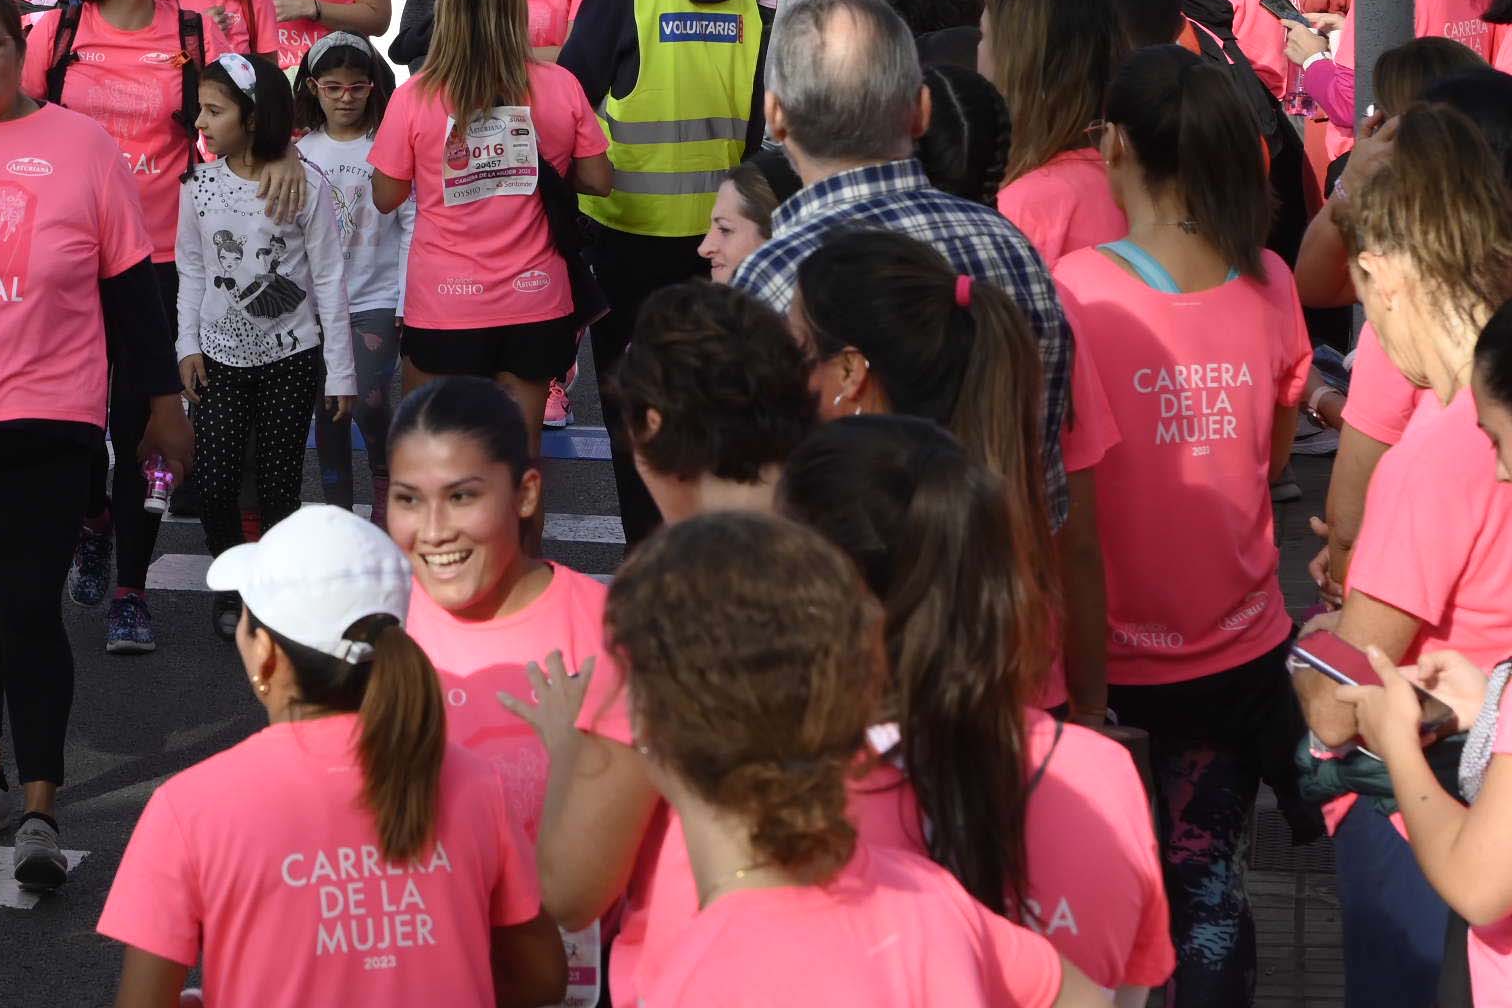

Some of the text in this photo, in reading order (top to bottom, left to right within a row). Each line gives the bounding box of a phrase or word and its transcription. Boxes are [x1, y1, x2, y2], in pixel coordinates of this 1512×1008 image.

[661, 19, 738, 38] VOLUNTARIS
[1443, 21, 1489, 37] CARRERA
[473, 143, 505, 159] 016
[10, 163, 51, 174] ASTURIANA
[475, 159, 502, 170] 20457
[453, 186, 481, 199] OYSHO
[438, 282, 484, 296] OYSHO
[1133, 362, 1254, 394] CARRERA
[1159, 390, 1233, 419] DE LA
[1155, 416, 1238, 445] MUJER
[1112, 628, 1183, 649] OYSHO
[319, 879, 425, 919] DE LA
[316, 914, 436, 956] MUJER
[364, 956, 397, 970] 2023
